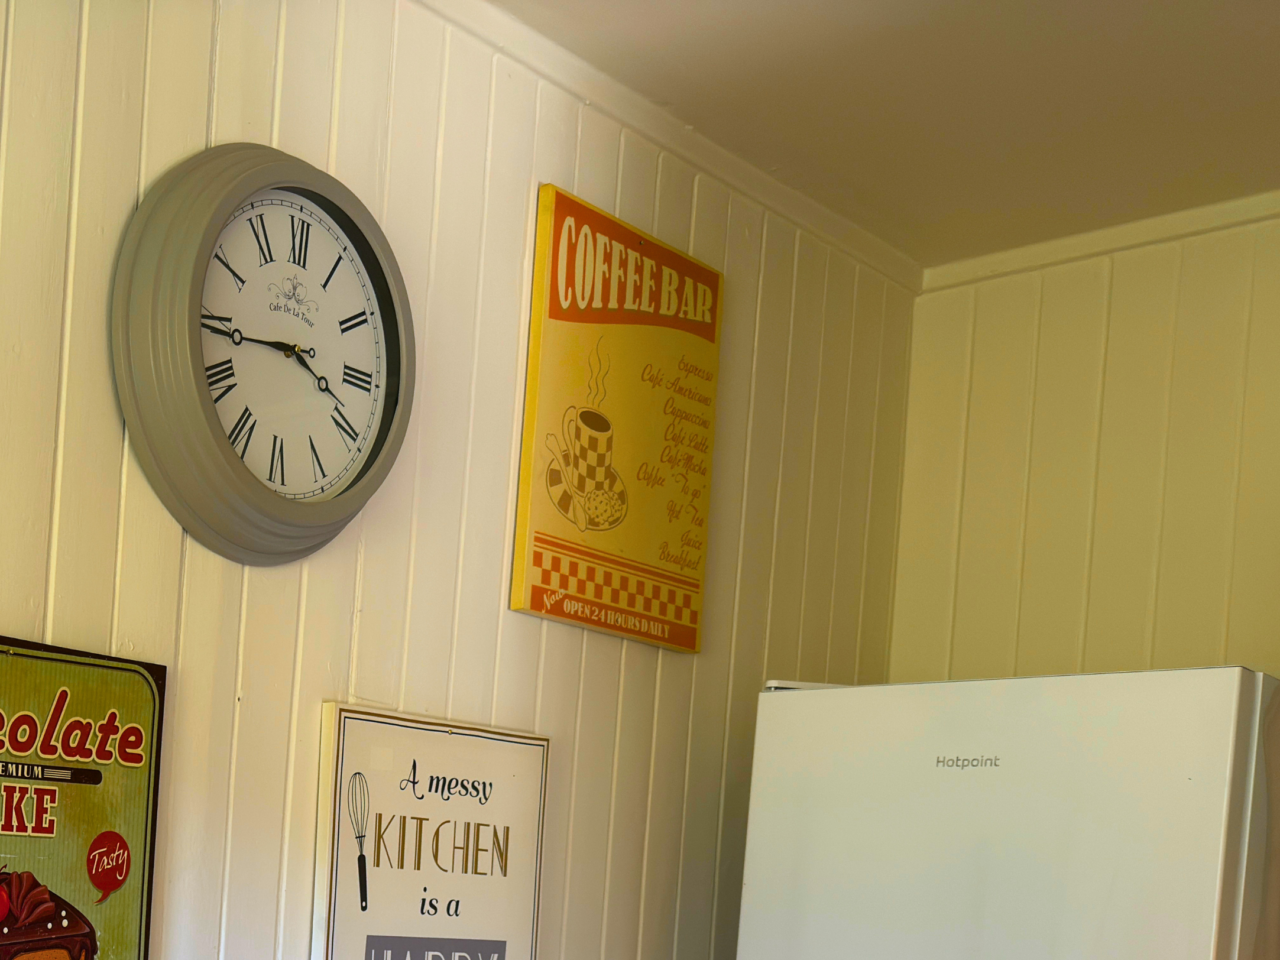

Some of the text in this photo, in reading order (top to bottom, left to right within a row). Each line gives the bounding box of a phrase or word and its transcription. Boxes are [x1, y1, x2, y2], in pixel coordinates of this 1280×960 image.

[246, 213, 276, 267] XI
[287, 214, 313, 271] XII
[213, 244, 246, 293] X
[320, 252, 345, 292] I
[557, 215, 713, 324] COFFEE BAR
[269, 302, 315, 328] Cafe De La Tour
[338, 308, 369, 335] II
[205, 357, 237, 404] VIII
[342, 361, 373, 396] III
[641, 363, 712, 407] Café Americano
[677, 354, 714, 382] Espresso
[663, 397, 711, 430] Cappuccino
[227, 405, 257, 464] VII
[686, 432, 709, 454] Latte
[266, 434, 287, 486] VI
[308, 434, 328, 483] V
[636, 461, 666, 489] Coffee
[666, 499, 704, 528] Hot Tea
[658, 541, 702, 572] Breakfast
[680, 529, 703, 551] Juice
[563, 598, 591, 619] OPEN
[591, 605, 605, 623] 24
[606, 609, 641, 631] HOURS
[640, 618, 670, 639] DAILY
[399, 758, 493, 806] A messy
[936, 755, 1001, 771] Hotpoint
[89, 843, 130, 880] Tasty
[372, 812, 511, 878] KITCHEN
[419, 886, 461, 918] is a
